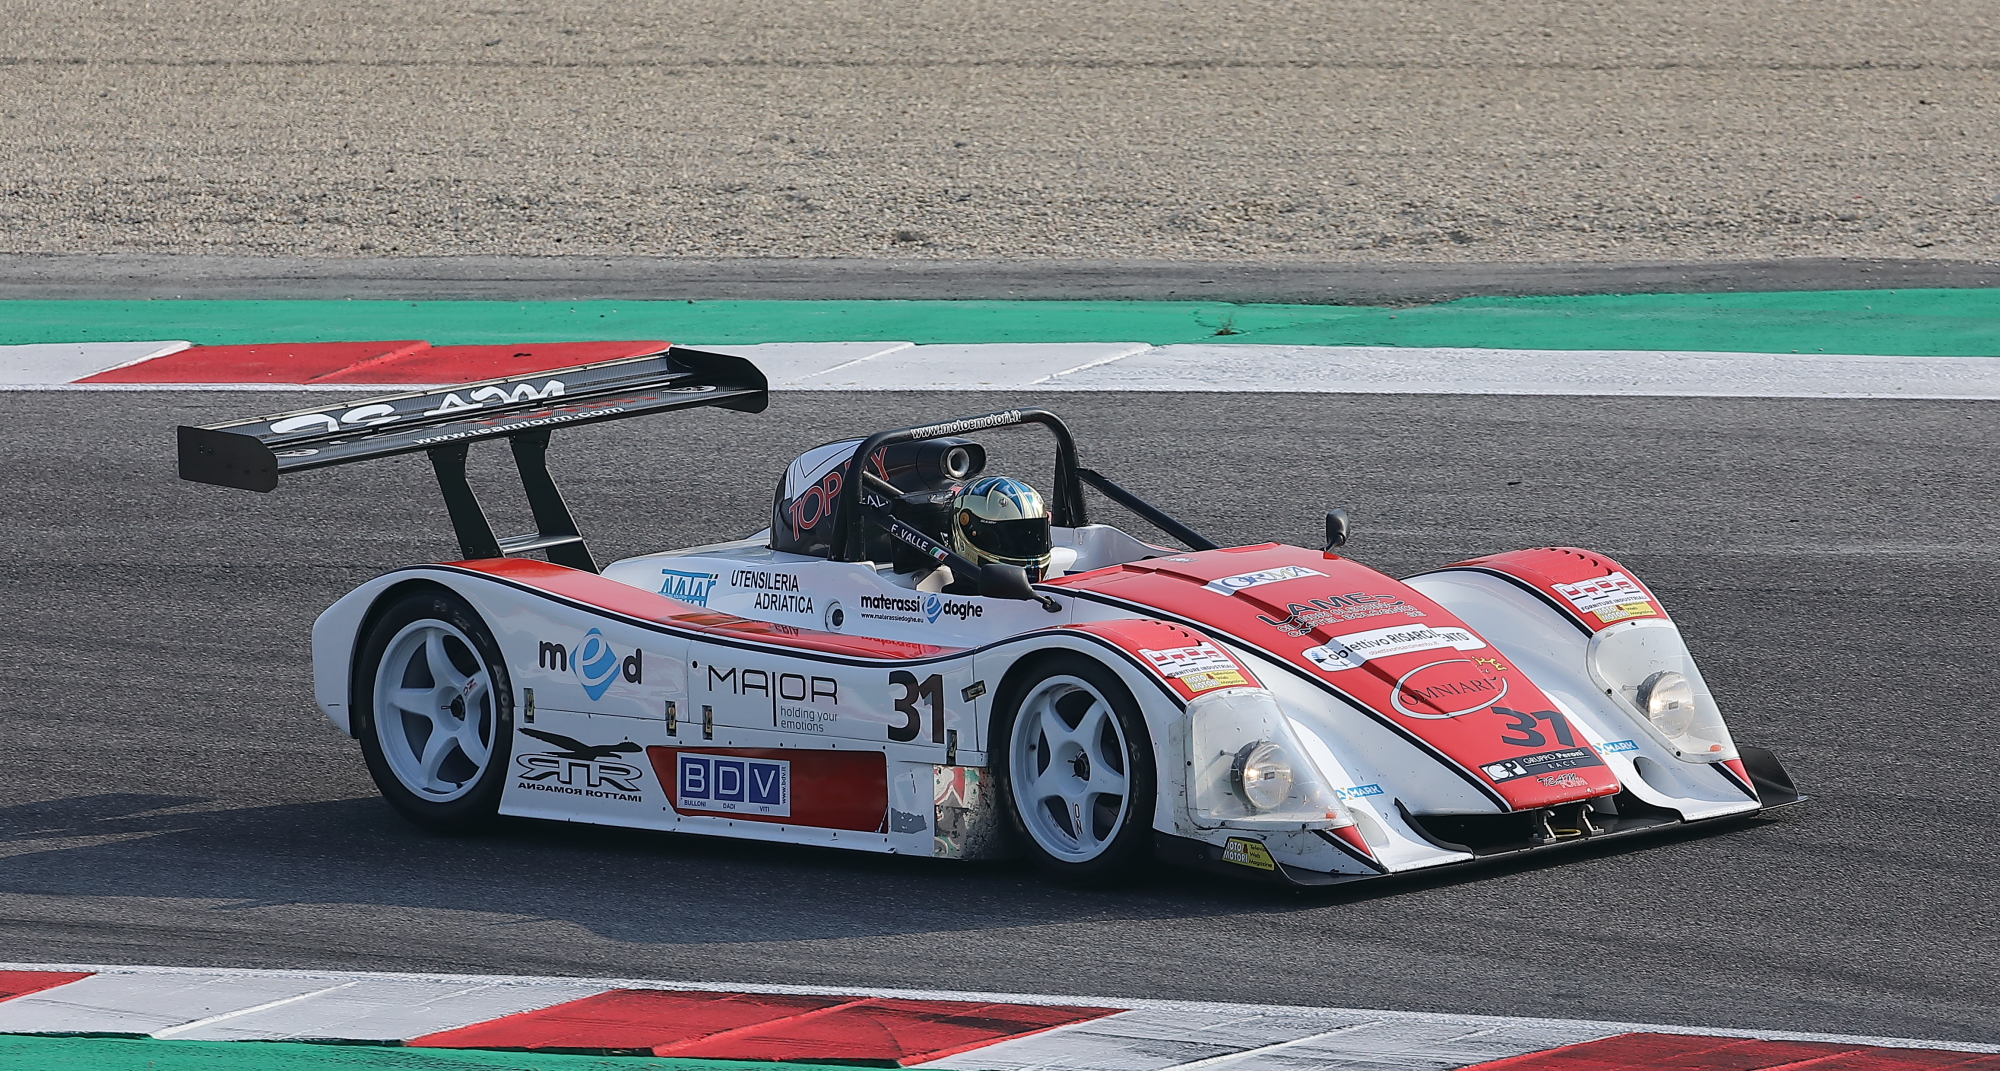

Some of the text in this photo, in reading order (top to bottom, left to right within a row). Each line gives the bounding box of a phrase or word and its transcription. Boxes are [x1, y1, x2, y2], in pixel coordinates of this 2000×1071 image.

[413, 406, 625, 445] www.teamform.com
[911, 410, 1021, 438] www.motoemotori.it
[789, 472, 842, 541] TOP
[901, 529, 929, 551] VALLE
[731, 570, 799, 592] UTENSILERIA
[754, 593, 814, 614] ADRIATICA
[861, 594, 921, 613] materassi
[943, 599, 983, 621] doghe
[1581, 600, 1613, 611] FORNITURE
[539, 633, 642, 687] med
[1328, 639, 1391, 661] obiettivo
[780, 705, 838, 723] holding your
[887, 670, 945, 745] 31
[780, 719, 824, 733] emotions
[1491, 706, 1575, 748] 31
[1523, 753, 1556, 764] GRUPPO
[1556, 750, 1584, 759] Peroni
[1548, 760, 1577, 769] RACE
[684, 799, 706, 807] BULLONI
[1223, 850, 1248, 863] MOTORI
[1249, 859, 1272, 868] Magazine
